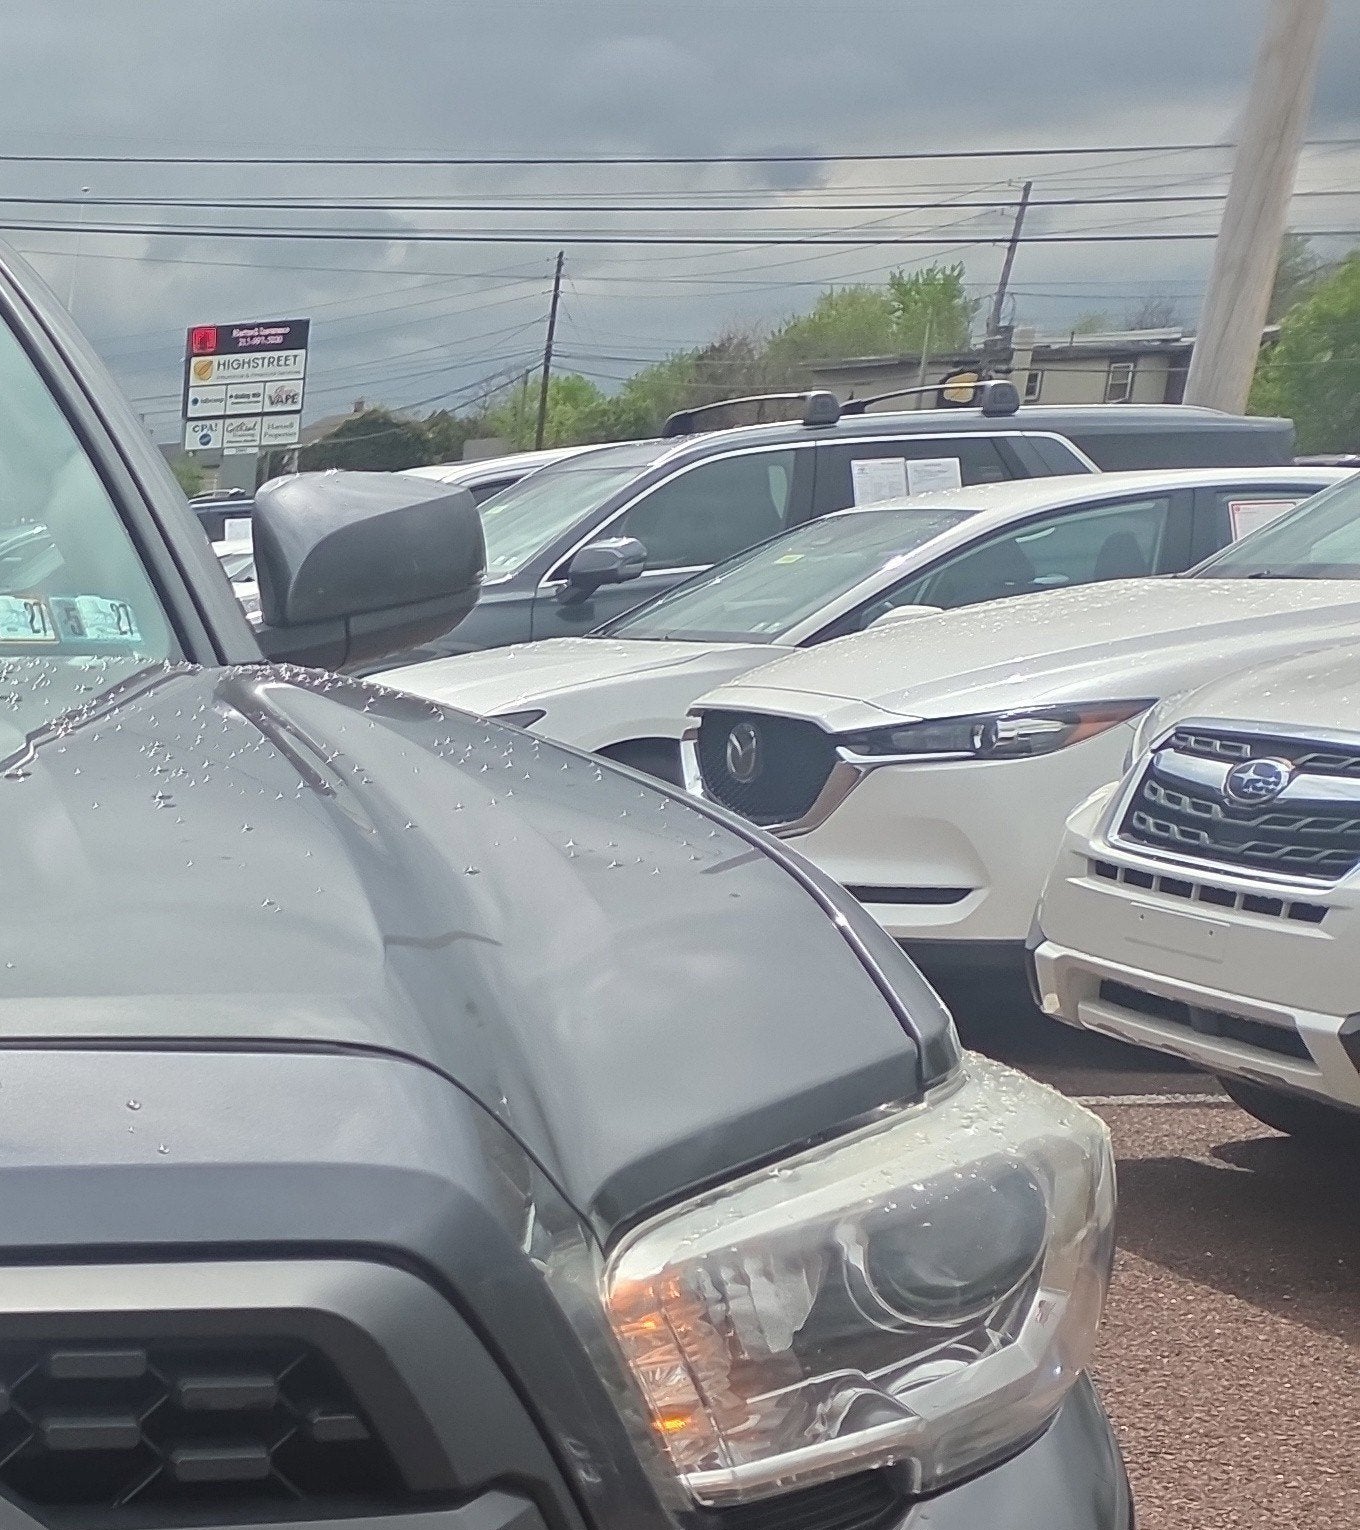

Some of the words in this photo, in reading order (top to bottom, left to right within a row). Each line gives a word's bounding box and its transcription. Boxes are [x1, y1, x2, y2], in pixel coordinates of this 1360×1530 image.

[217, 355, 299, 371] HIGHSTREET
[268, 393, 299, 406] VAPE
[64, 607, 84, 636] 5
